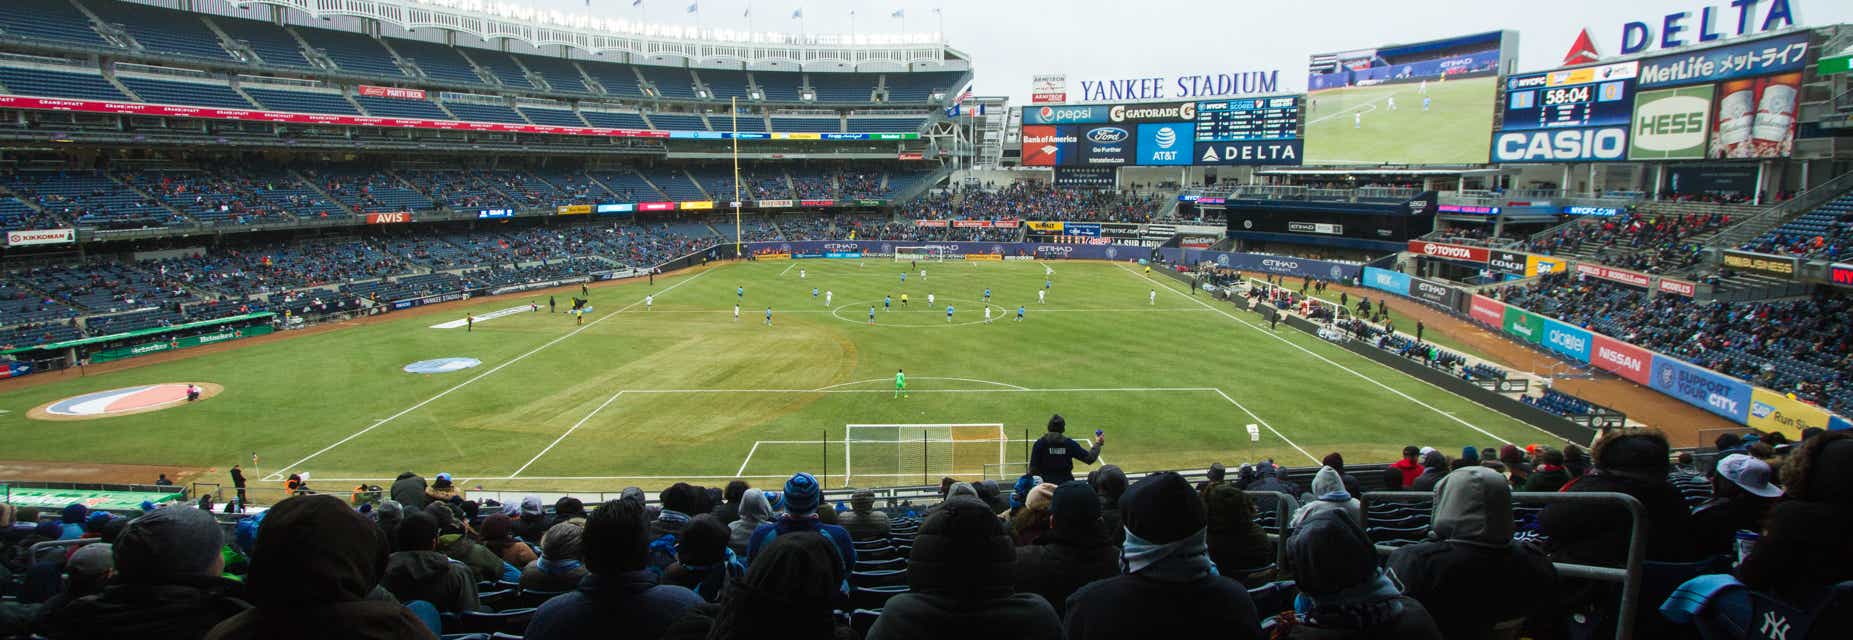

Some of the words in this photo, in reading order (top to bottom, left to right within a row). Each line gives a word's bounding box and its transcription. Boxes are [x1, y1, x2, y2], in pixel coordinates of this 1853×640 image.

[1620, 0, 1793, 55] DELTA
[1639, 56, 1714, 84] MetLife
[1719, 42, 1808, 74] メットライフ
[1081, 77, 1164, 101] YANKEE
[1176, 70, 1279, 97] STADIUM
[1545, 86, 1590, 105] 58:04
[1605, 85, 1615, 99] 0
[1056, 108, 1091, 121] pepsi
[1126, 107, 1178, 119] GATORADE
[1639, 112, 1704, 136] HESS
[1094, 129, 1120, 141] Ford
[1497, 128, 1625, 160] CASIO
[1153, 151, 1177, 160] AT&T
[1225, 145, 1295, 160] DELTA
[376, 212, 403, 223] AVIS
[1437, 246, 1471, 258] TOYOTA
[1262, 259, 1298, 269] ETIHAD
[1491, 259, 1524, 270] COACH
[1419, 283, 1446, 296] ETIHAD
[1599, 346, 1641, 372] NISSAN
[1678, 369, 1731, 397] SUPPORT
[1677, 381, 1707, 401] YOUR
[1774, 411, 1794, 427] Run
